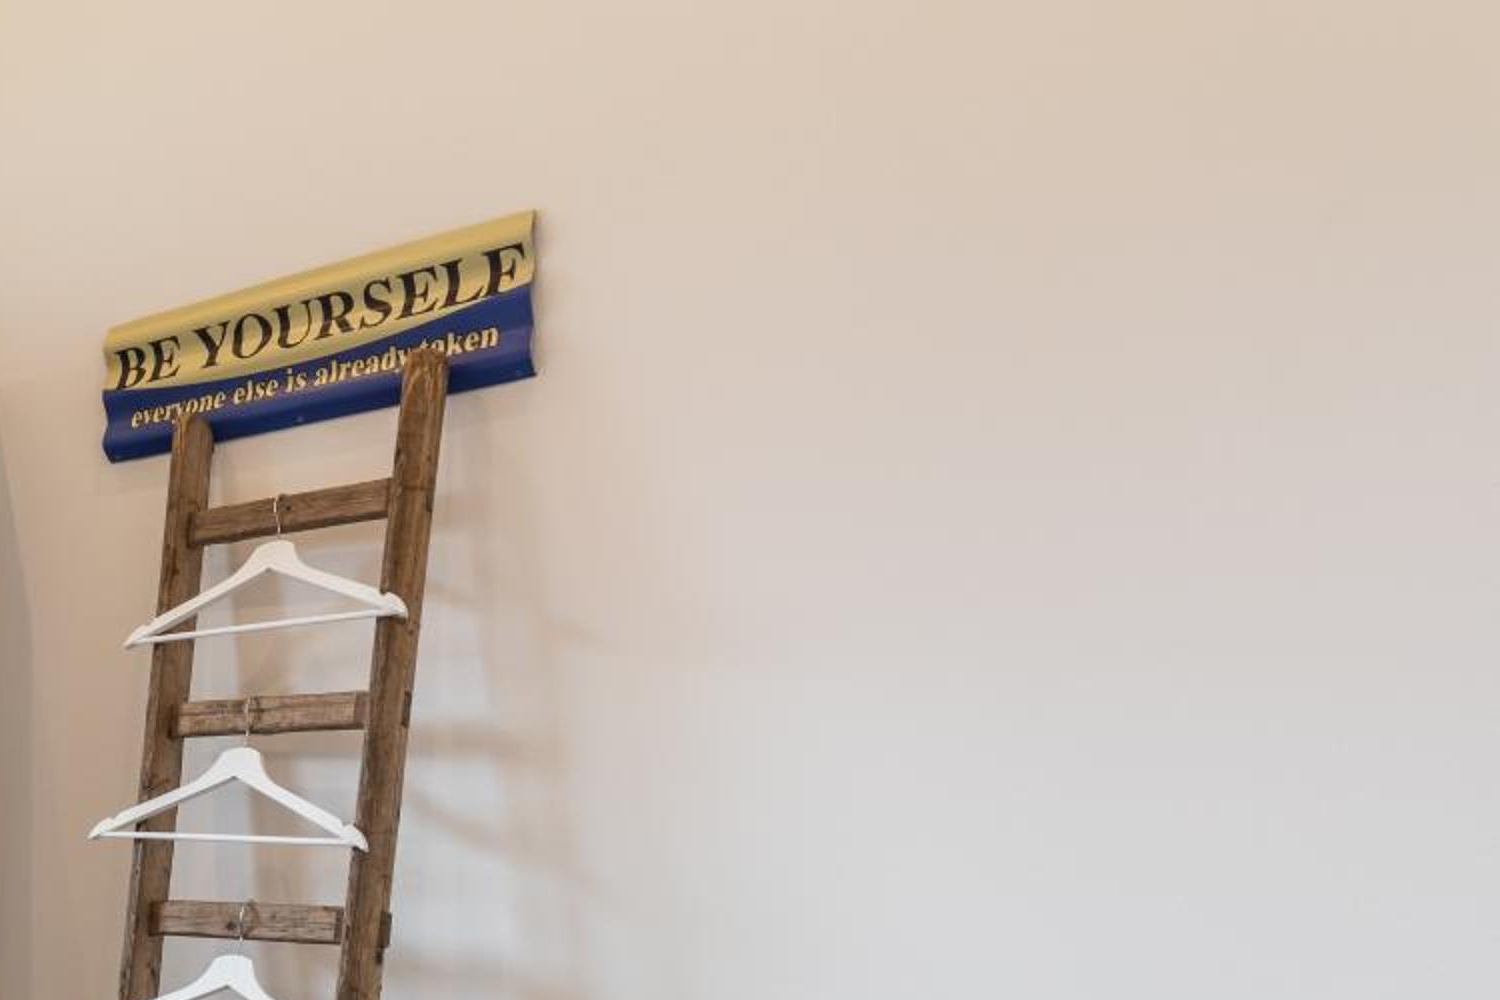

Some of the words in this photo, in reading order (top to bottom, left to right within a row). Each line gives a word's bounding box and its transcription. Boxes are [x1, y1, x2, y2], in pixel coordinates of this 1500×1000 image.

[114, 335, 182, 390] BE
[192, 241, 527, 368] YOURSELF
[130, 392, 226, 428] everyone
[233, 378, 279, 404] else
[285, 367, 308, 393] is
